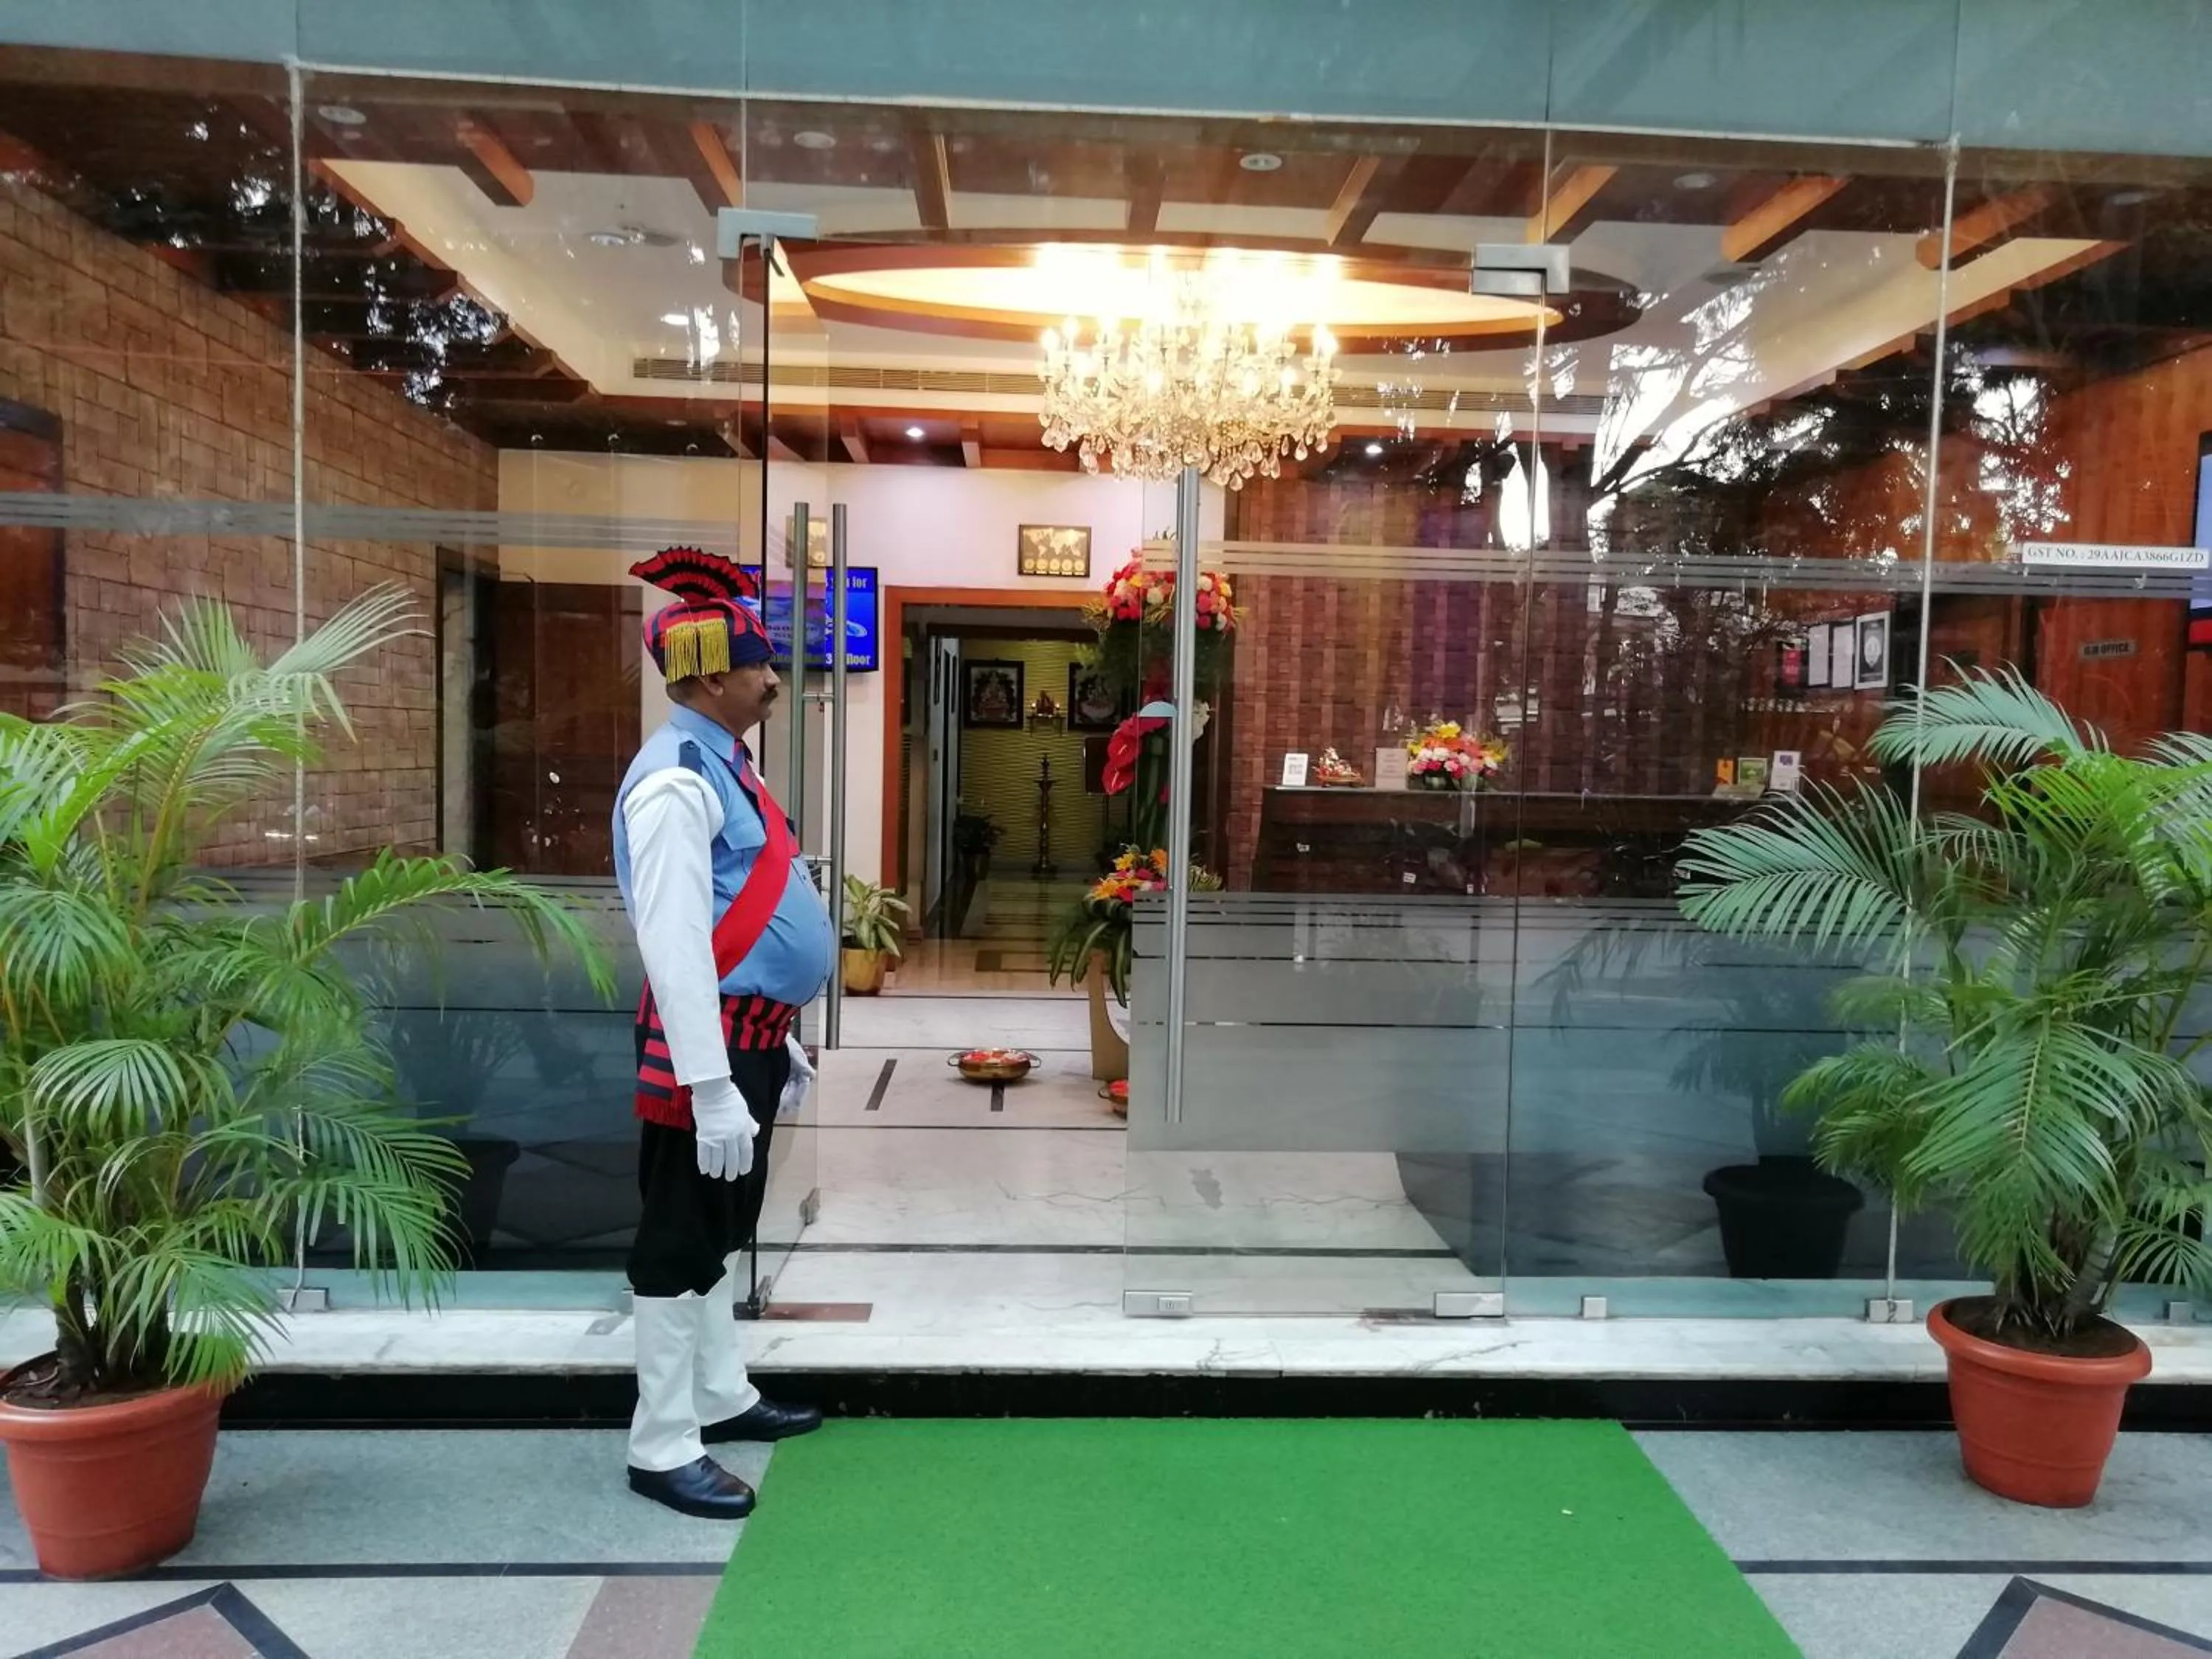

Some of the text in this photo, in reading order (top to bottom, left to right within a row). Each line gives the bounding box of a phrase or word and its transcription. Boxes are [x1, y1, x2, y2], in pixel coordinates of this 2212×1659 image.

[2028, 547, 2053, 557] GST
[852, 576, 868, 588] for
[2100, 642, 2129, 655] OFFICE
